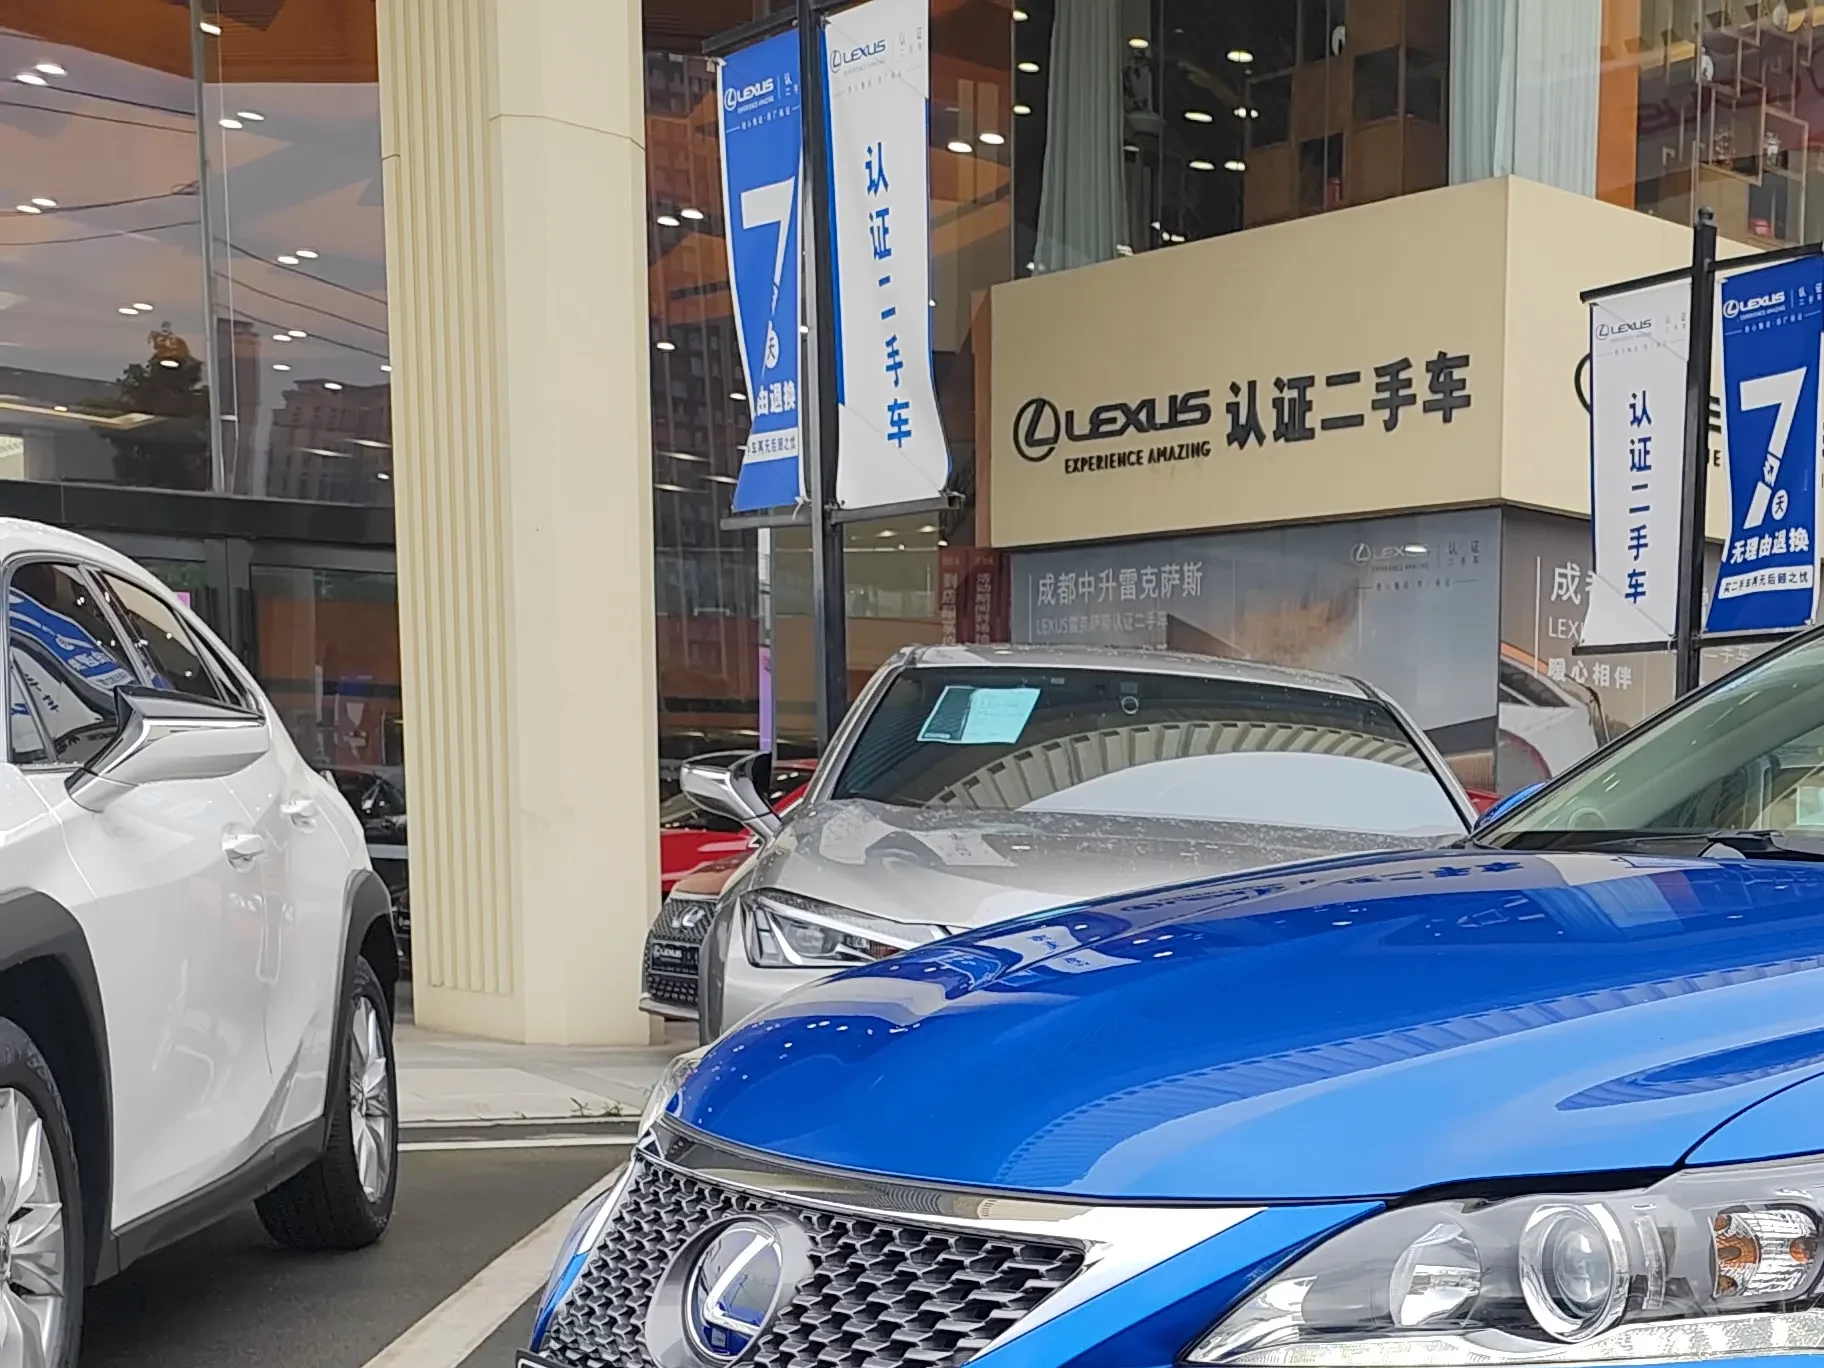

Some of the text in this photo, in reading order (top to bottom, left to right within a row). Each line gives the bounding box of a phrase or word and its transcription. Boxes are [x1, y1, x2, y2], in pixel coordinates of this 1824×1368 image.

[843, 39, 886, 64] LEXUS
[737, 77, 775, 102] LEXUS
[865, 142, 913, 448] 认证二手车
[1740, 291, 1785, 311] LEXUS
[1611, 319, 1652, 334] LEXUS
[1065, 389, 1212, 442] LEXUS
[1225, 351, 1472, 450] 认证二手车
[1064, 441, 1212, 474] EXPERIENCE AMAZING
[1739, 366, 1807, 529] 7
[1625, 391, 1653, 605] 认证二手车
[1373, 544, 1429, 560] LEX
[1730, 527, 1809, 564] 无理由退换
[1037, 561, 1203, 606] 成都中升雷克萨斯
[1551, 561, 1595, 605] 成
[1548, 657, 1632, 690] 暖心相伴
